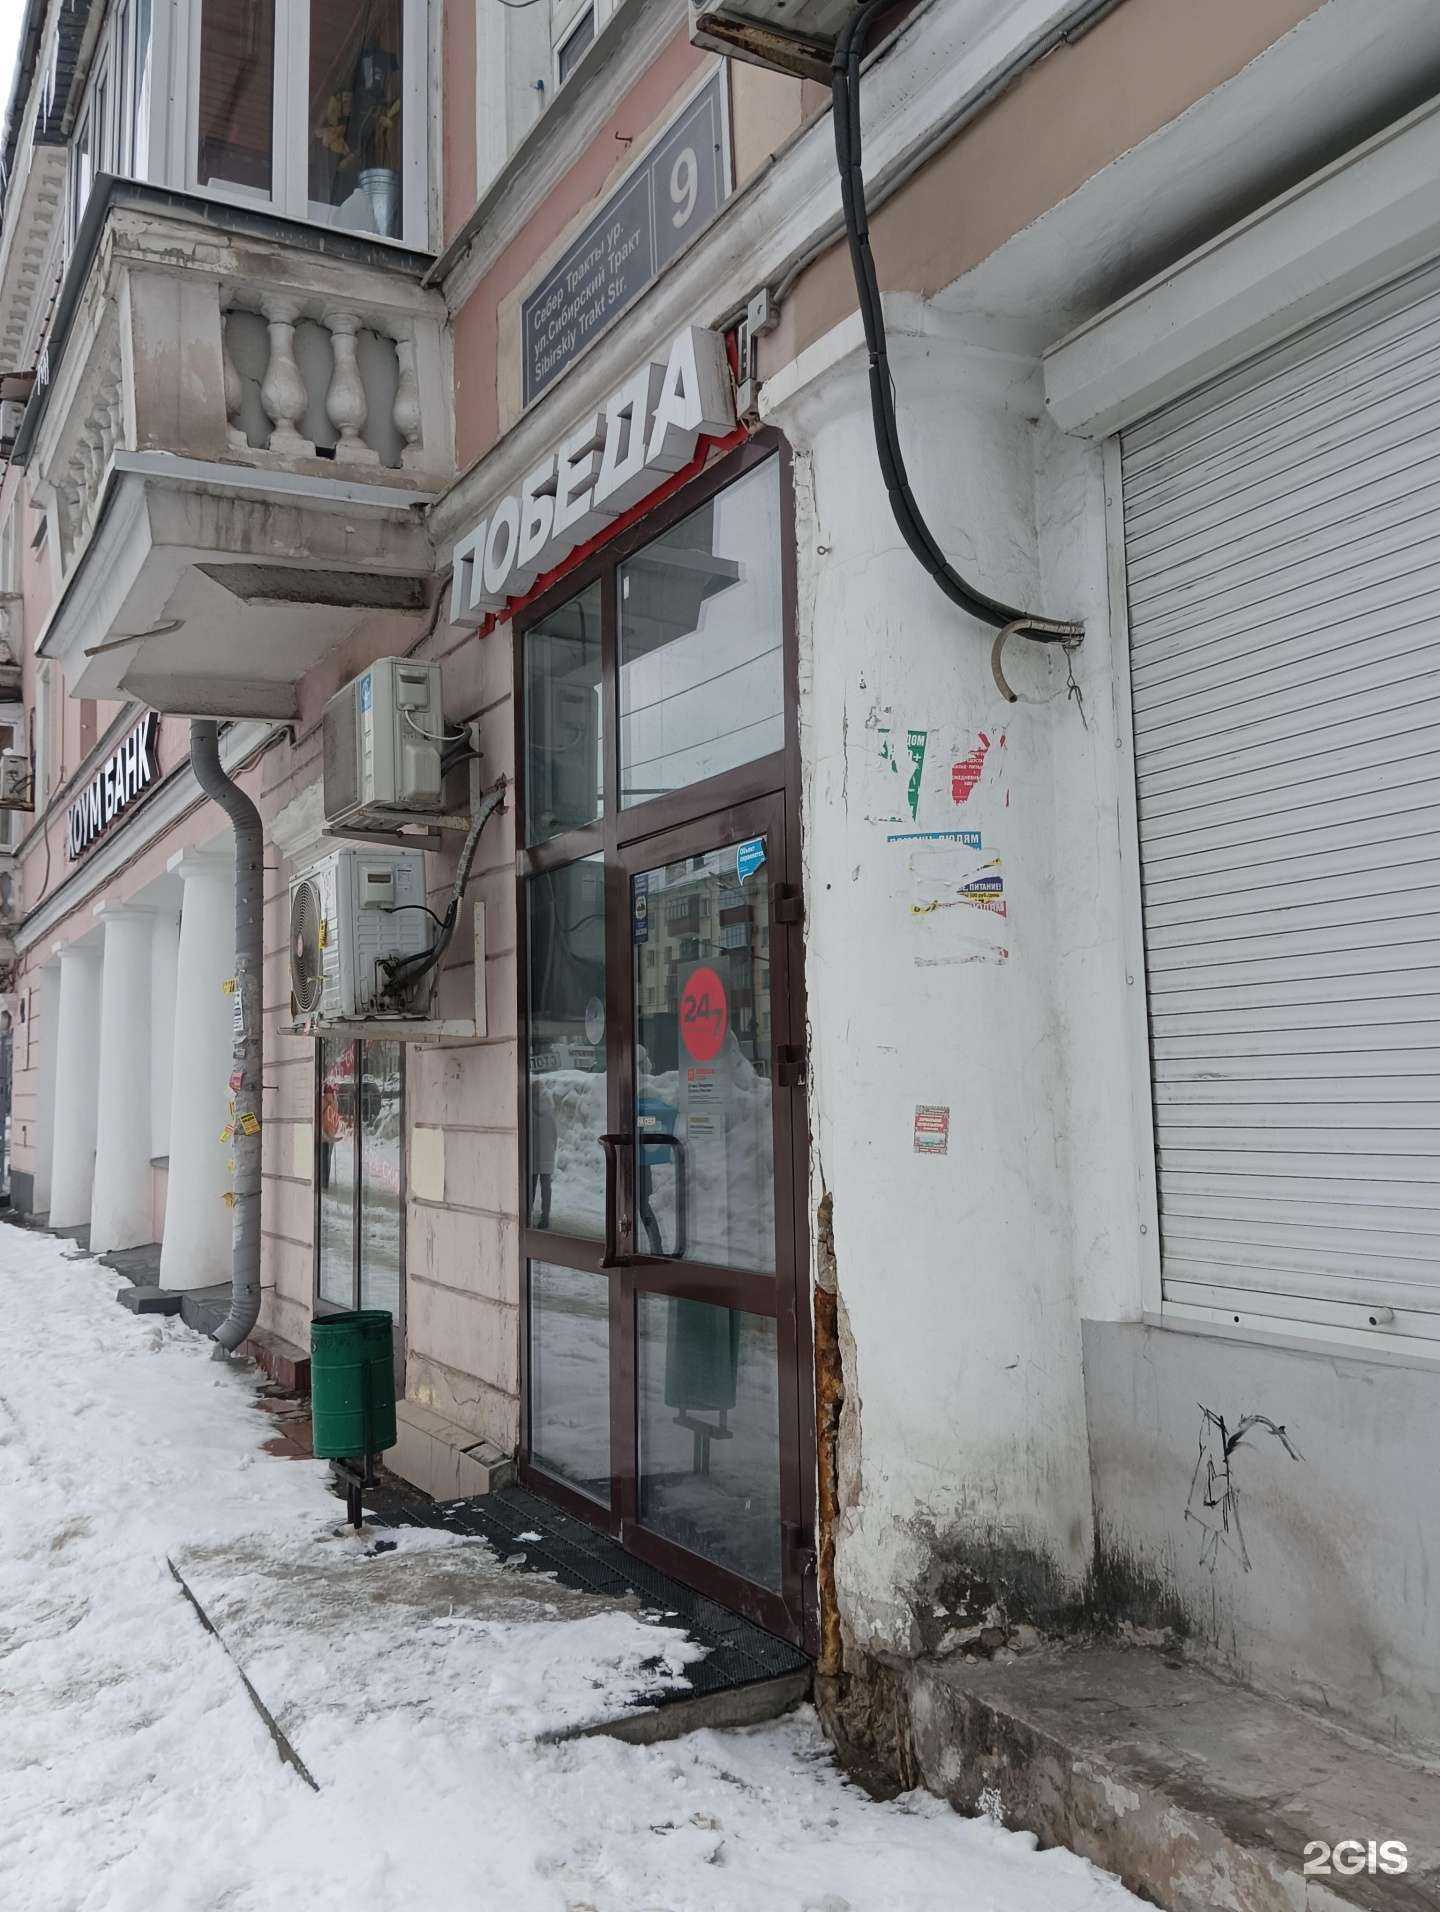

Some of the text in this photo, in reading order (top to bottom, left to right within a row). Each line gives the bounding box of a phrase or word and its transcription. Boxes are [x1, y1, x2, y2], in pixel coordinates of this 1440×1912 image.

[670, 147, 698, 229] 9
[534, 223, 624, 330] Себер Тракты ур.
[608, 229, 641, 273] Тракт
[535, 276, 627, 382] Sibirskiy Trakt Str.
[450, 326, 704, 625] ПОБЕДА
[105, 711, 152, 824] БАНК
